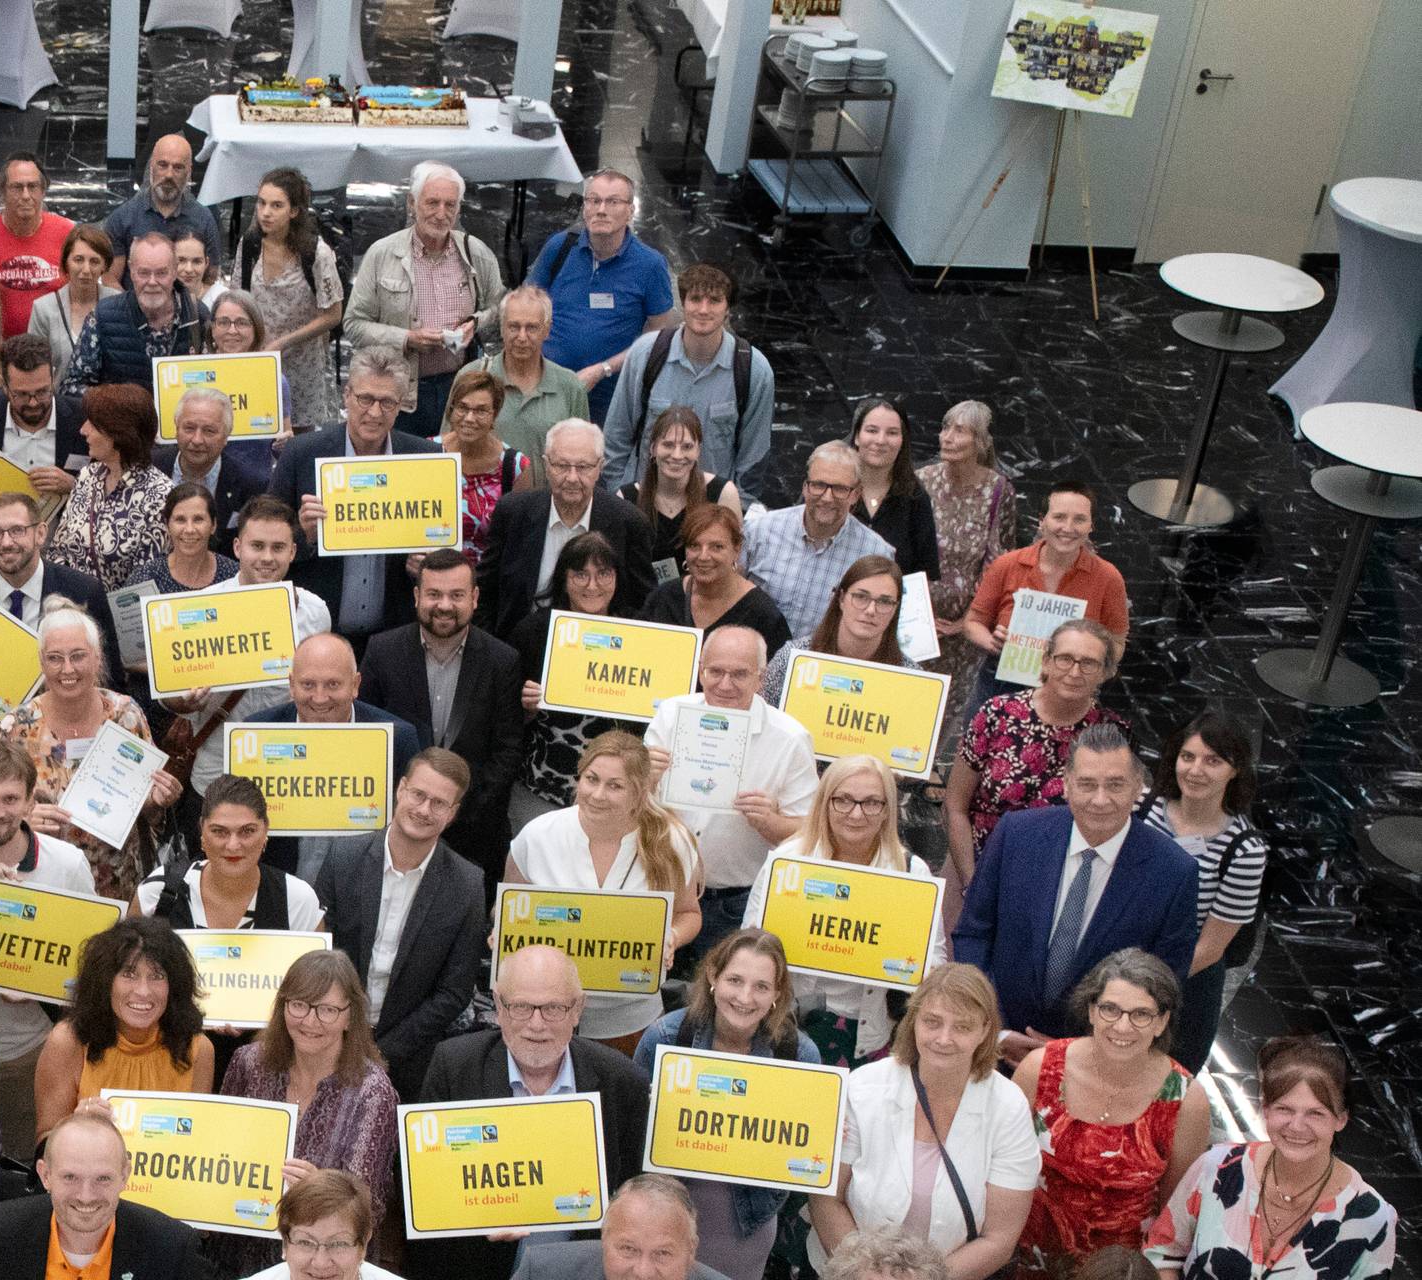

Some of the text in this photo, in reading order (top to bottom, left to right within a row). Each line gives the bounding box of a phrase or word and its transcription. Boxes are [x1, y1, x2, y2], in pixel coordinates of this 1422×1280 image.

[230, 394, 248, 410] EN
[324, 464, 344, 493] 10
[335, 500, 442, 522] BERGKAMEN
[152, 602, 172, 632] 10
[1020, 594, 1080, 618] 10 JAHRE
[171, 632, 273, 661] SCHWERTE
[558, 622, 579, 648] 10
[1009, 633, 1043, 650] METRO
[174, 664, 186, 673] ist
[1001, 644, 1043, 675] RU
[587, 661, 652, 688] KAMEN
[796, 660, 818, 689] 10
[826, 703, 890, 735] LÜNEN
[235, 732, 258, 764] 10
[822, 732, 834, 740] ist
[775, 864, 800, 896] 10
[507, 892, 530, 924] 10
[810, 913, 882, 945] HERNE
[806, 941, 819, 950] ist
[197, 972, 283, 990] KLINGHAU
[666, 1057, 692, 1094] 10
[410, 1112, 438, 1152] 10
[678, 1108, 810, 1148] DORTMUND
[676, 1138, 689, 1149] ist
[462, 1160, 544, 1190] HAGEN
[464, 1195, 478, 1206] ist
